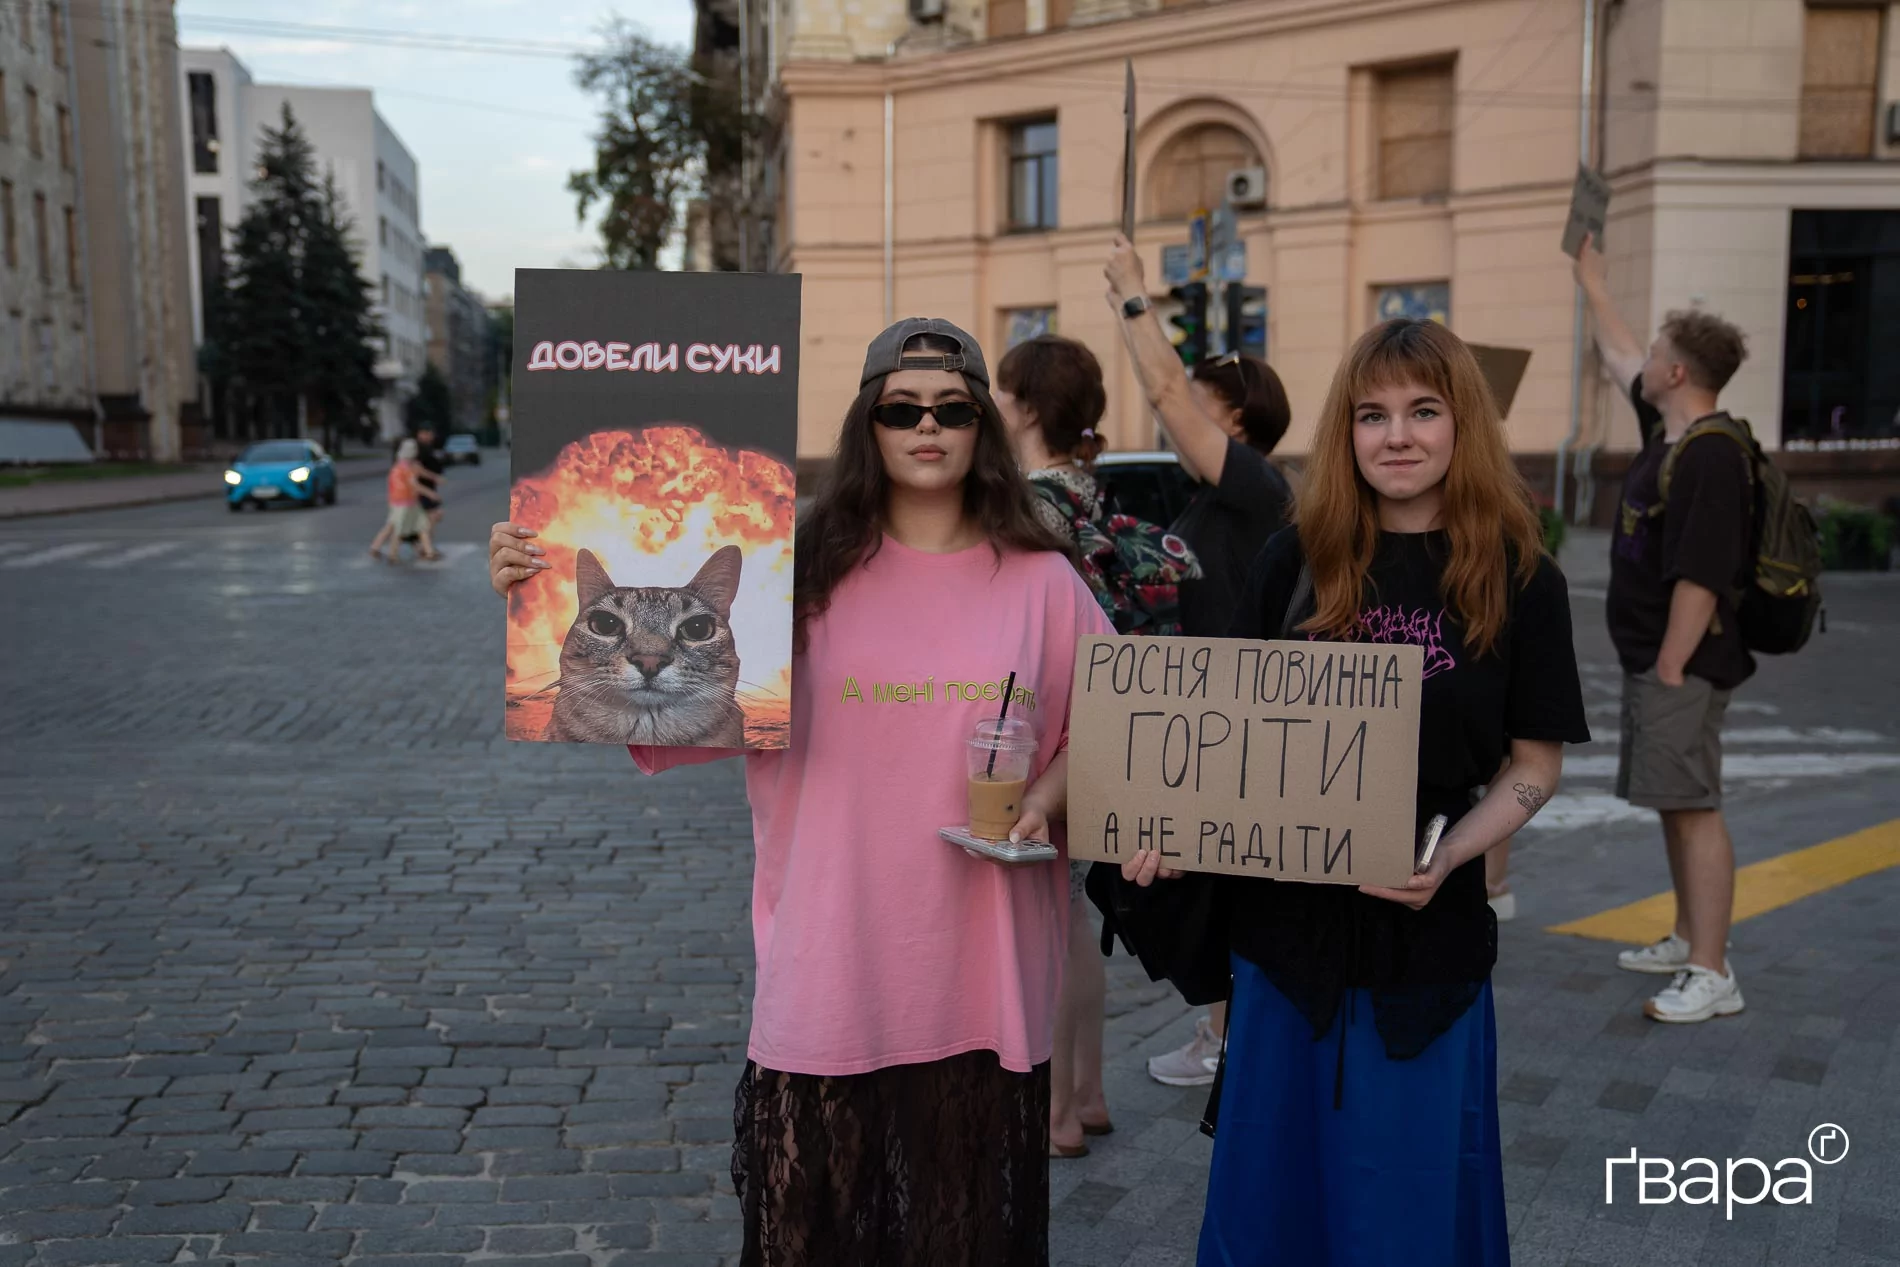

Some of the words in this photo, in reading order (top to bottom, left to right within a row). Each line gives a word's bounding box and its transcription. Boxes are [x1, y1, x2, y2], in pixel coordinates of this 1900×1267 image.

[527, 341, 679, 373] ДОВЕЛИ
[685, 343, 781, 374] СУКИ
[841, 676, 863, 703] А
[873, 676, 934, 703] мені
[1087, 643, 1212, 698] РОСНЯ
[1235, 648, 1403, 708] ПОВИННА
[1126, 711, 1368, 801] ГОРІТИ
[1104, 812, 1119, 853] А
[1138, 816, 1181, 857] НЕ
[1198, 821, 1352, 875] РАДІТИ
